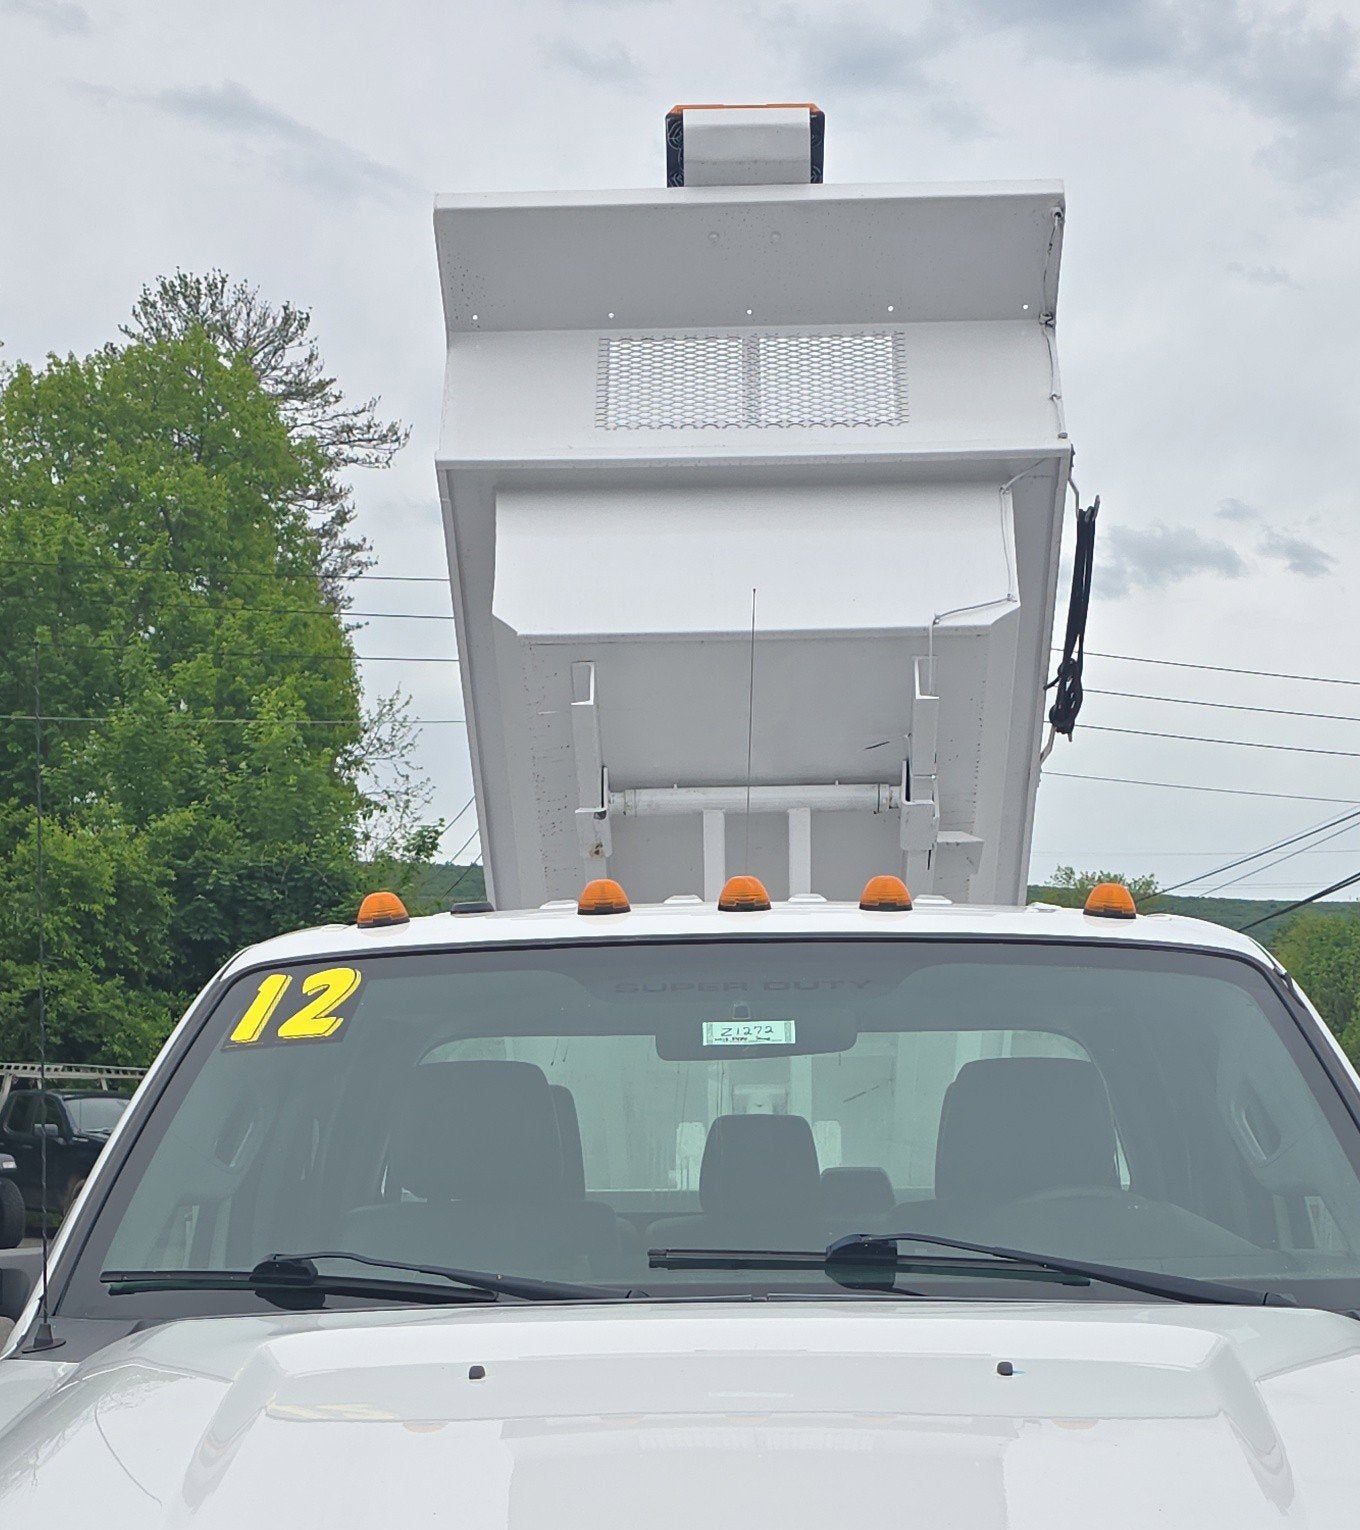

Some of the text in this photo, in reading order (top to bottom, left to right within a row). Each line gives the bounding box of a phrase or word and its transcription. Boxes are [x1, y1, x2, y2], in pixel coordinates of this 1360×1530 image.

[230, 967, 362, 1043] 12
[614, 979, 873, 993] SUPER DUTY
